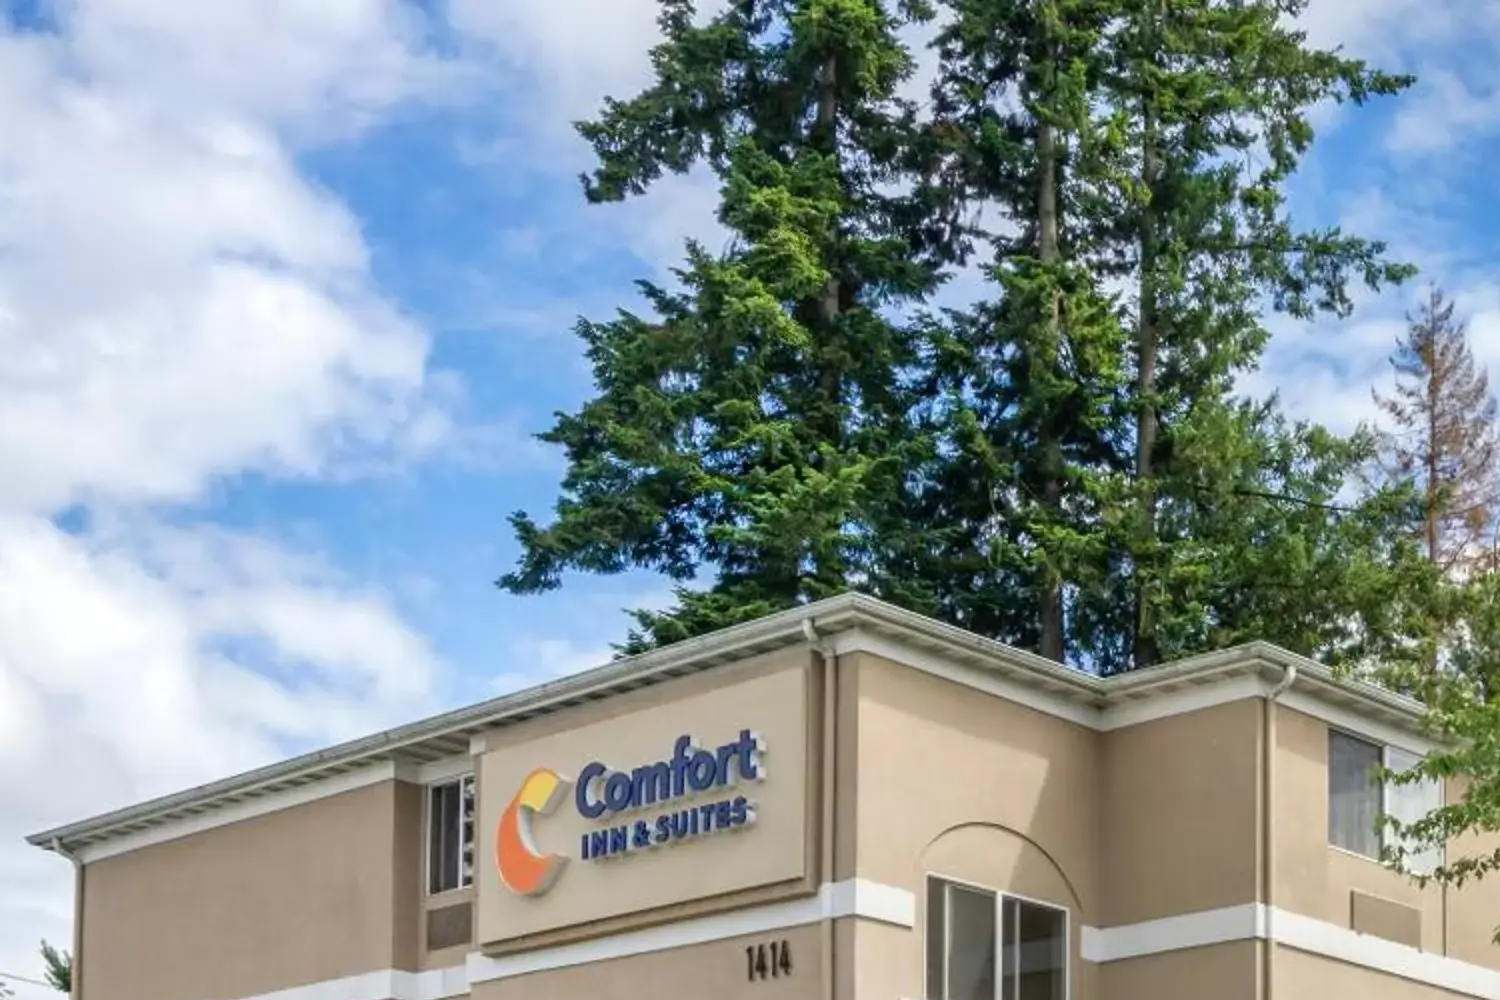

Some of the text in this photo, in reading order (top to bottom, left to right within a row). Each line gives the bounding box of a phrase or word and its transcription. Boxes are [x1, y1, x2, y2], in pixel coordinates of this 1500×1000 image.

[576, 729, 760, 819] Comfort
[581, 795, 752, 861] INN & SUITES
[746, 939, 793, 983] 1414
